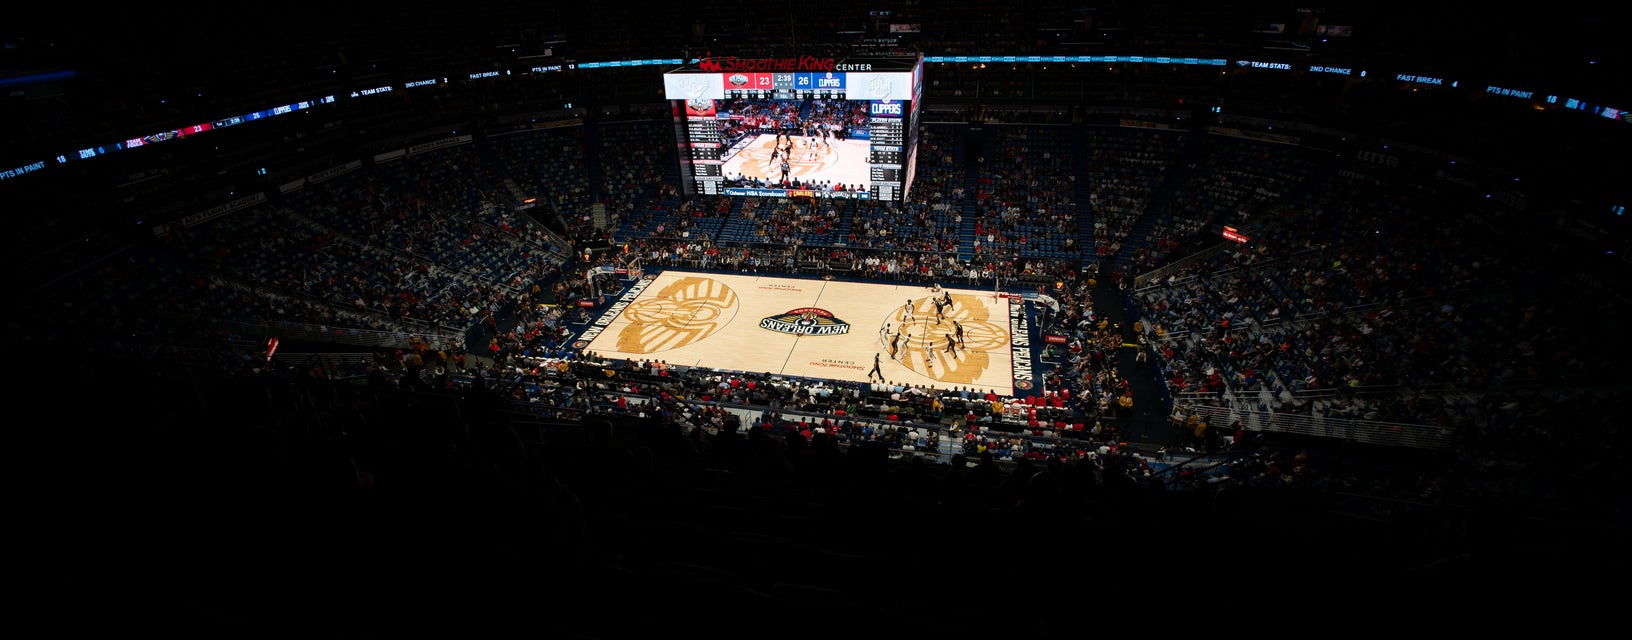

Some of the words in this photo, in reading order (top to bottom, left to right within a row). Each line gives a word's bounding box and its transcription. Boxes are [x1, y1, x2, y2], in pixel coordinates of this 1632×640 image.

[725, 56, 796, 71] SMOOTHIE
[1251, 61, 1269, 69] TEAM
[1324, 67, 1352, 75] CHANCE
[1396, 74, 1416, 83] FAST
[1416, 76, 1443, 85] BREAK
[361, 88, 375, 96] TEAM
[415, 79, 436, 87] CHANCE
[759, 77, 770, 86] 23
[798, 76, 809, 85] 26
[818, 78, 840, 87] CLIPPERS
[1486, 86, 1501, 95] PTS
[1501, 88, 1510, 96] IN
[1510, 90, 1534, 99] PAINT
[871, 103, 901, 114] CLIPPERS
[193, 125, 202, 133] 23
[0, 169, 16, 180] PTS
[15, 167, 25, 176] IN
[24, 160, 45, 173] PAINT
[56, 155, 66, 163] 18
[577, 325, 604, 341] NEW
[595, 301, 630, 326] ORLEANS
[619, 279, 653, 302] PELICANS
[760, 318, 814, 334] ORLEANS
[816, 324, 849, 335] NEW
[1012, 346, 1033, 381] PELICANS
